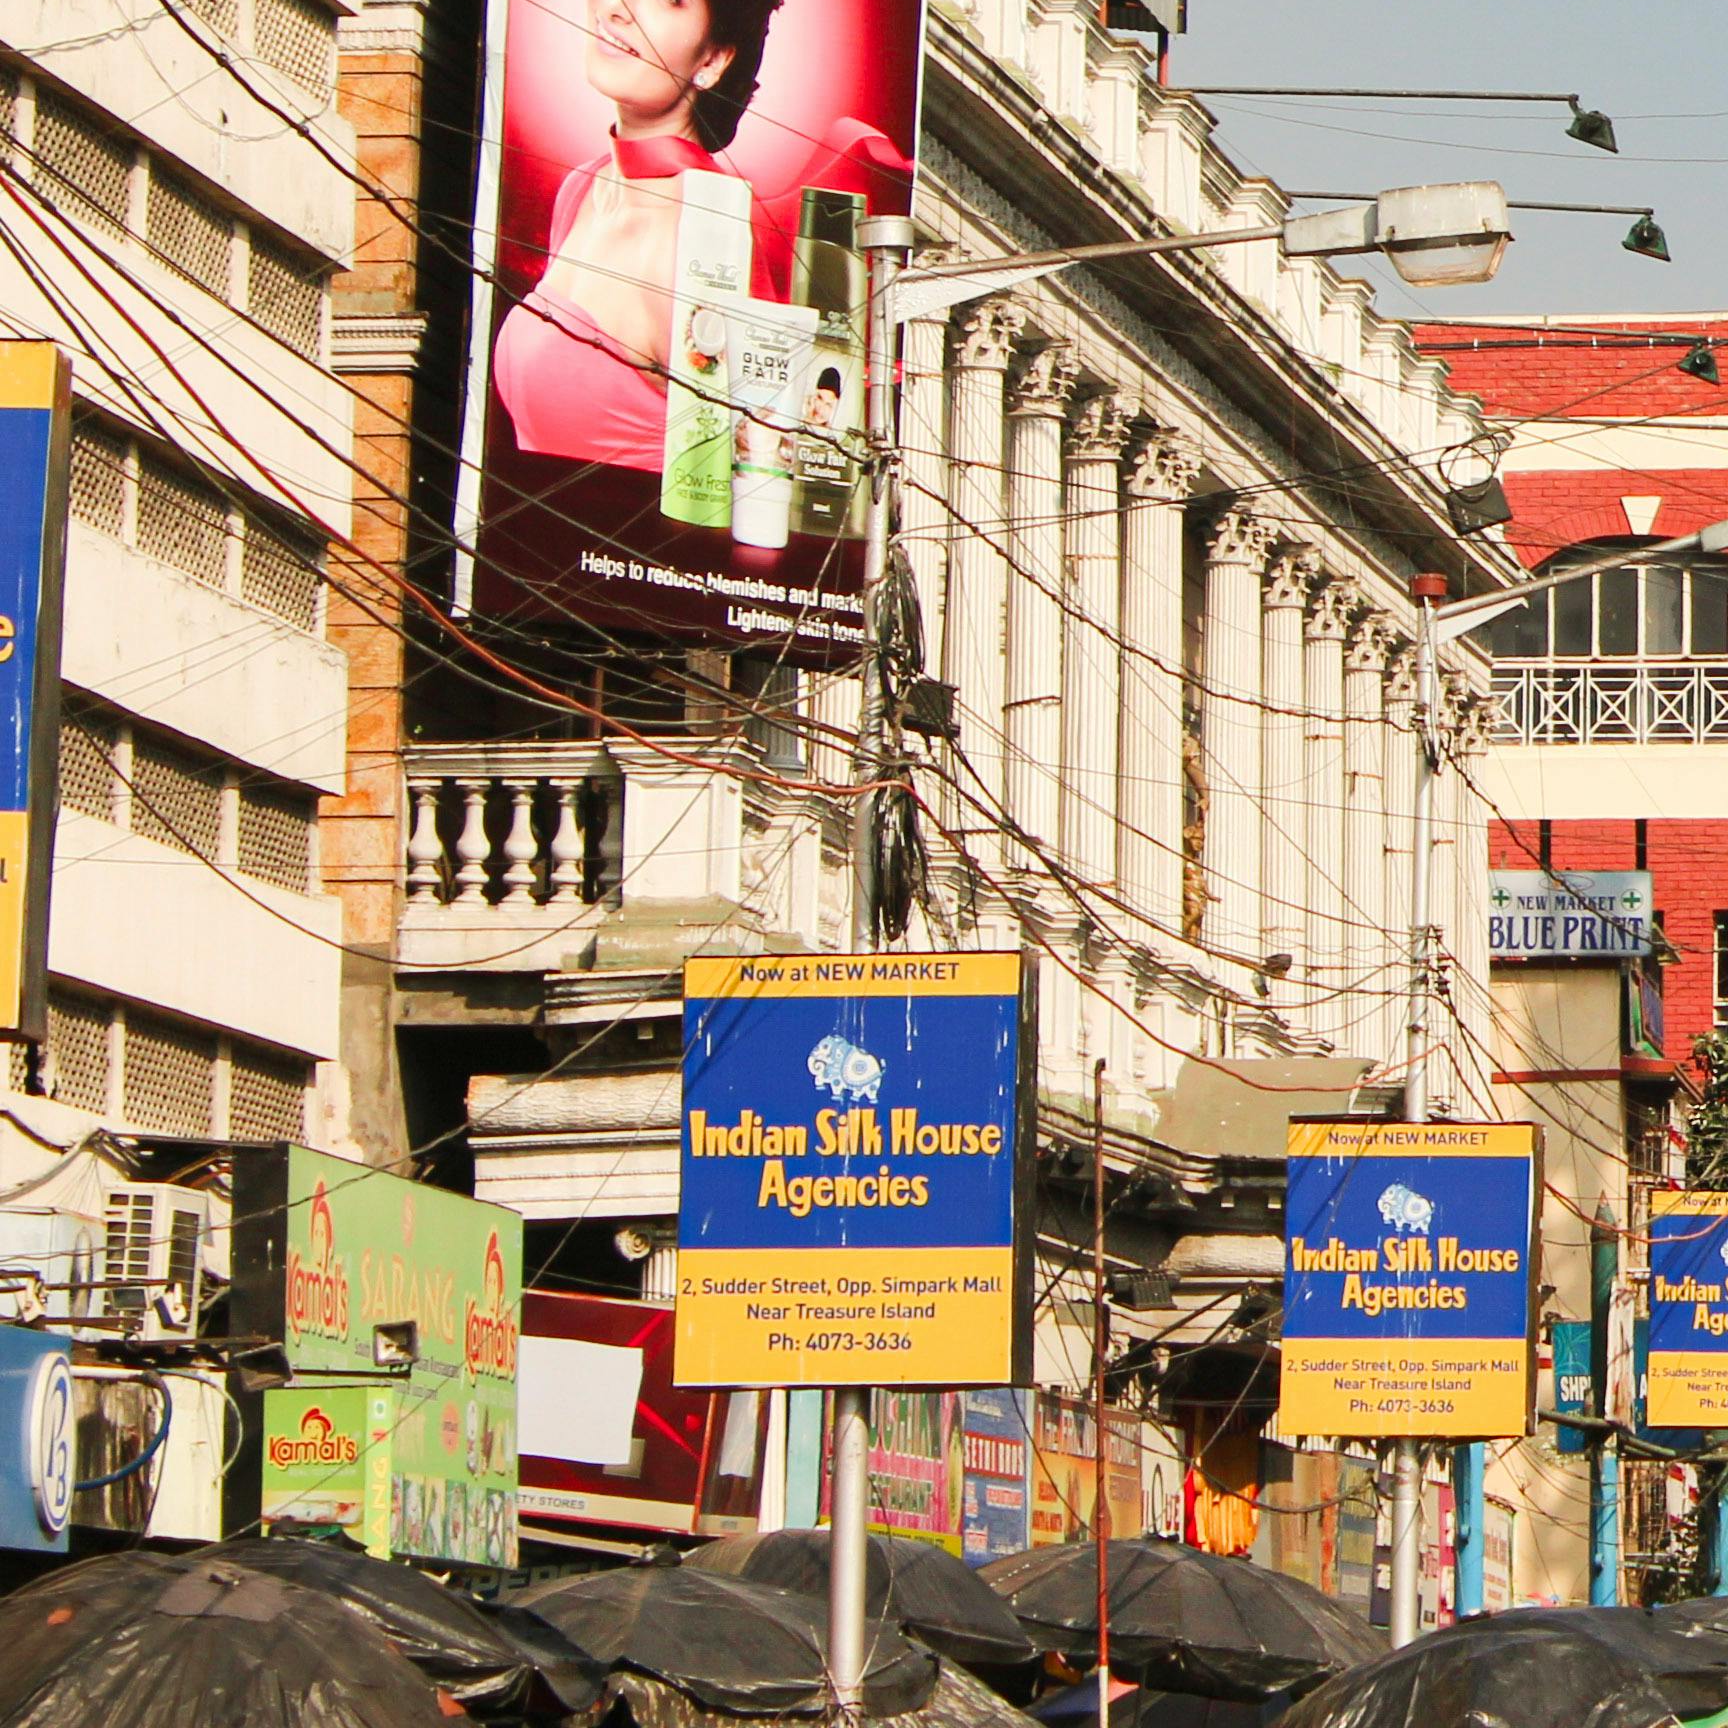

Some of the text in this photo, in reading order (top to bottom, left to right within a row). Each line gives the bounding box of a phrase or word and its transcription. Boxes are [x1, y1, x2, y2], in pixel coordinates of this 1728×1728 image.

[742, 352, 789, 369] GLOW
[742, 365, 789, 382] FAIR
[580, 550, 625, 580] Helps
[628, 559, 643, 581] to
[706, 572, 787, 604] blemishes
[788, 585, 819, 607] and
[1517, 896, 1617, 912] NEW MARKET
[1489, 916, 1645, 951] BLUE PRINT
[740, 962, 960, 982] Now at NEW MARKET
[689, 1107, 1003, 1158] Indian Silk House
[1328, 1131, 1489, 1146] Now at NEW MARKET
[757, 1159, 931, 1217] Agencies
[1290, 1236, 1519, 1273] Indian Silk House
[285, 1248, 350, 1345] Kamal's
[681, 1275, 1003, 1298] 2, Sudder Street, Opp. Simpark Mall
[1341, 1273, 1468, 1317] Agencies
[1654, 1275, 1722, 1304] Indian
[746, 1302, 937, 1320] Near Treasure Island
[767, 1333, 913, 1353] Ph: 4073-3636
[1286, 1358, 1520, 1375] 2, Sudder Street, Opp. Simpark Mall
[1333, 1377, 1473, 1391] Near Treasure Island
[1350, 1399, 1455, 1414] Ph: 4073-3636
[267, 1433, 359, 1470] Kamal's
[538, 1494, 586, 1511] STORES
